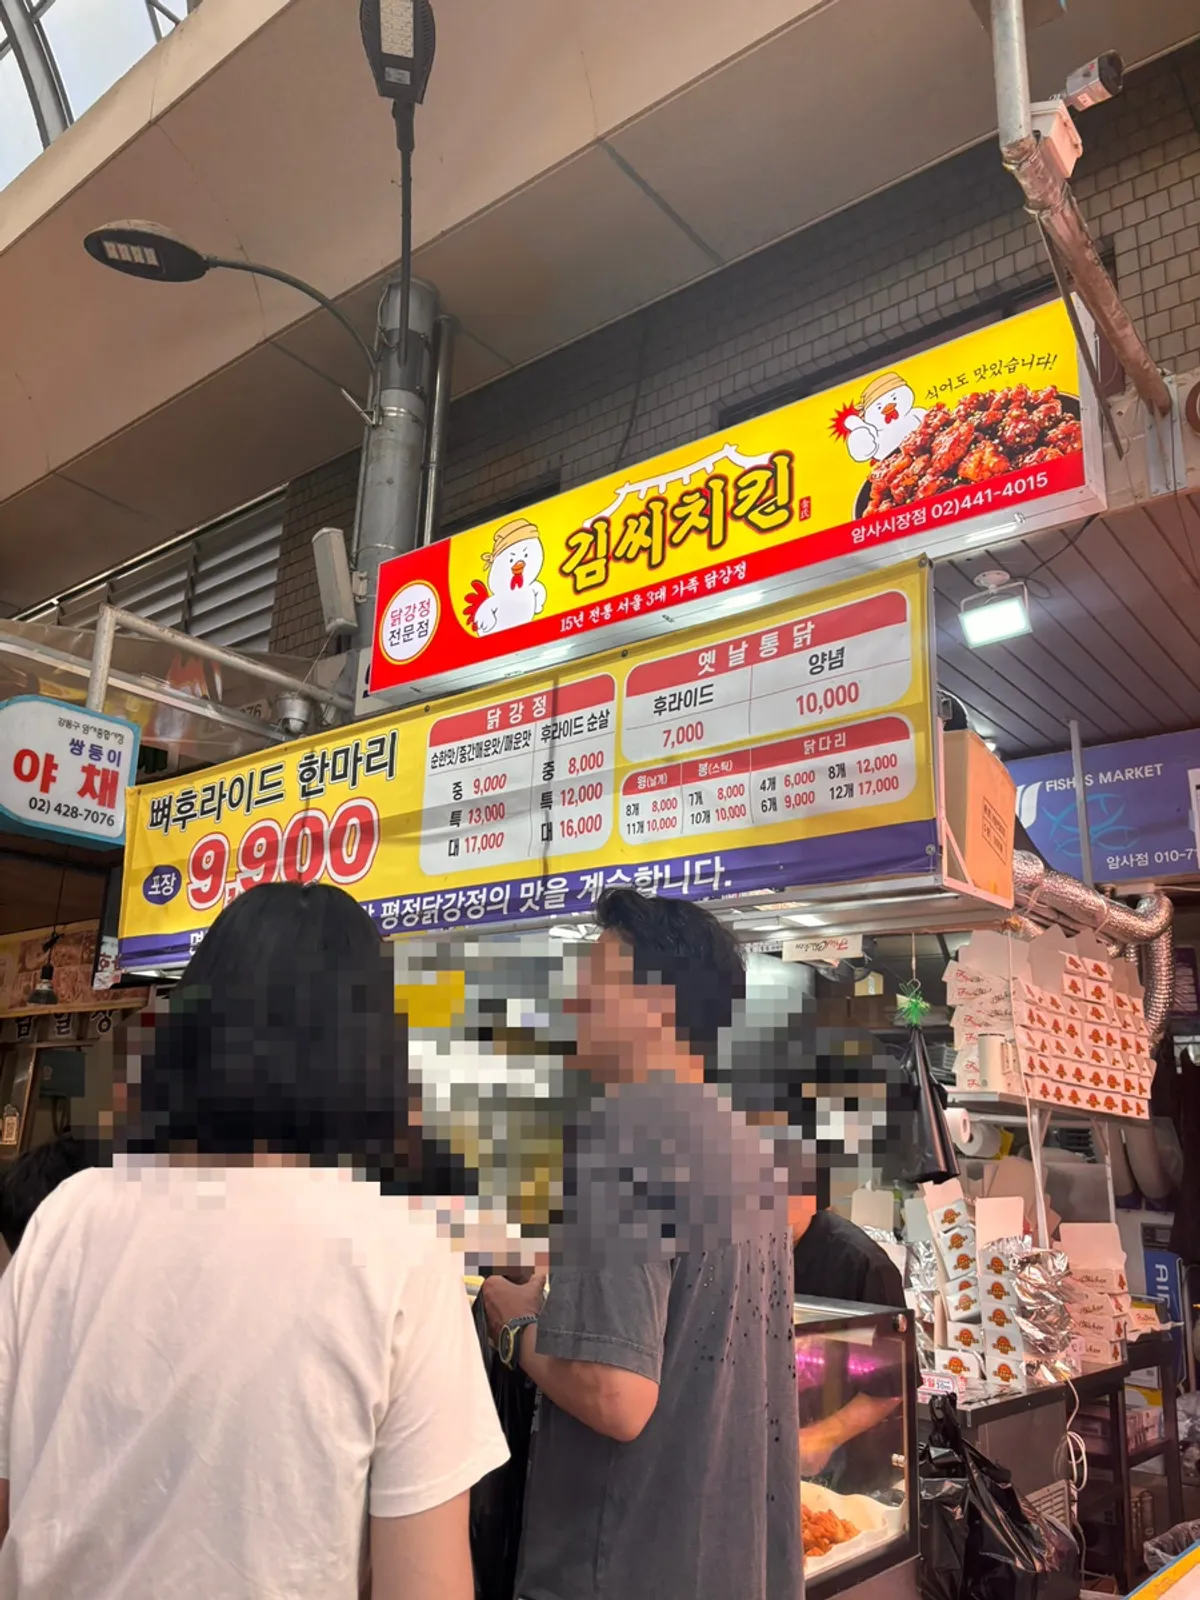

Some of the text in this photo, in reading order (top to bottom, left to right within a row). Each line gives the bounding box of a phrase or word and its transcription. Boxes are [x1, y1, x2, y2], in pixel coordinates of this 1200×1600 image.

[925, 354, 1058, 400] 식어도 맛있습니다!
[851, 472, 1048, 544] 암사시장점 02)441-4015
[560, 451, 793, 593] 김씨치킨
[560, 561, 746, 632] 15년 전통 서울 3대 가족 닭강정
[390, 598, 430, 626] 닭강정
[388, 619, 429, 646] 전문점
[808, 646, 846, 675] 양념
[653, 683, 714, 716] 후라이드
[796, 681, 860, 716] 10,000
[541, 708, 610, 743] 후라이드 순살
[662, 721, 704, 748] 7,000
[542, 750, 604, 782] 중 8,000
[828, 754, 898, 780] 8개 12,000
[1099, 764, 1164, 784] MARKET
[149, 732, 398, 832] 뼈후라이드 한마리
[452, 774, 507, 800] 중 9,000
[760, 770, 816, 791] 4개 6,000
[829, 776, 899, 800] 12개 17,000
[560, 782, 603, 807] 12,000
[626, 798, 678, 816] 8개 8,000
[688, 784, 744, 806] 7개 8,000
[761, 791, 816, 812] 6개 9,000
[29, 797, 114, 826] 02) 428-7076
[468, 802, 505, 824] 13,000
[691, 804, 746, 825] 10개 10,000
[541, 814, 602, 842] 대 16,000
[627, 816, 677, 835] 11개 10,000
[448, 832, 504, 856] 대 17,000
[1106, 848, 1197, 870] 암사점 010-7
[148, 873, 176, 896] 포장
[380, 884, 510, 929] 평정닭강정의
[520, 877, 569, 912] 맛을
